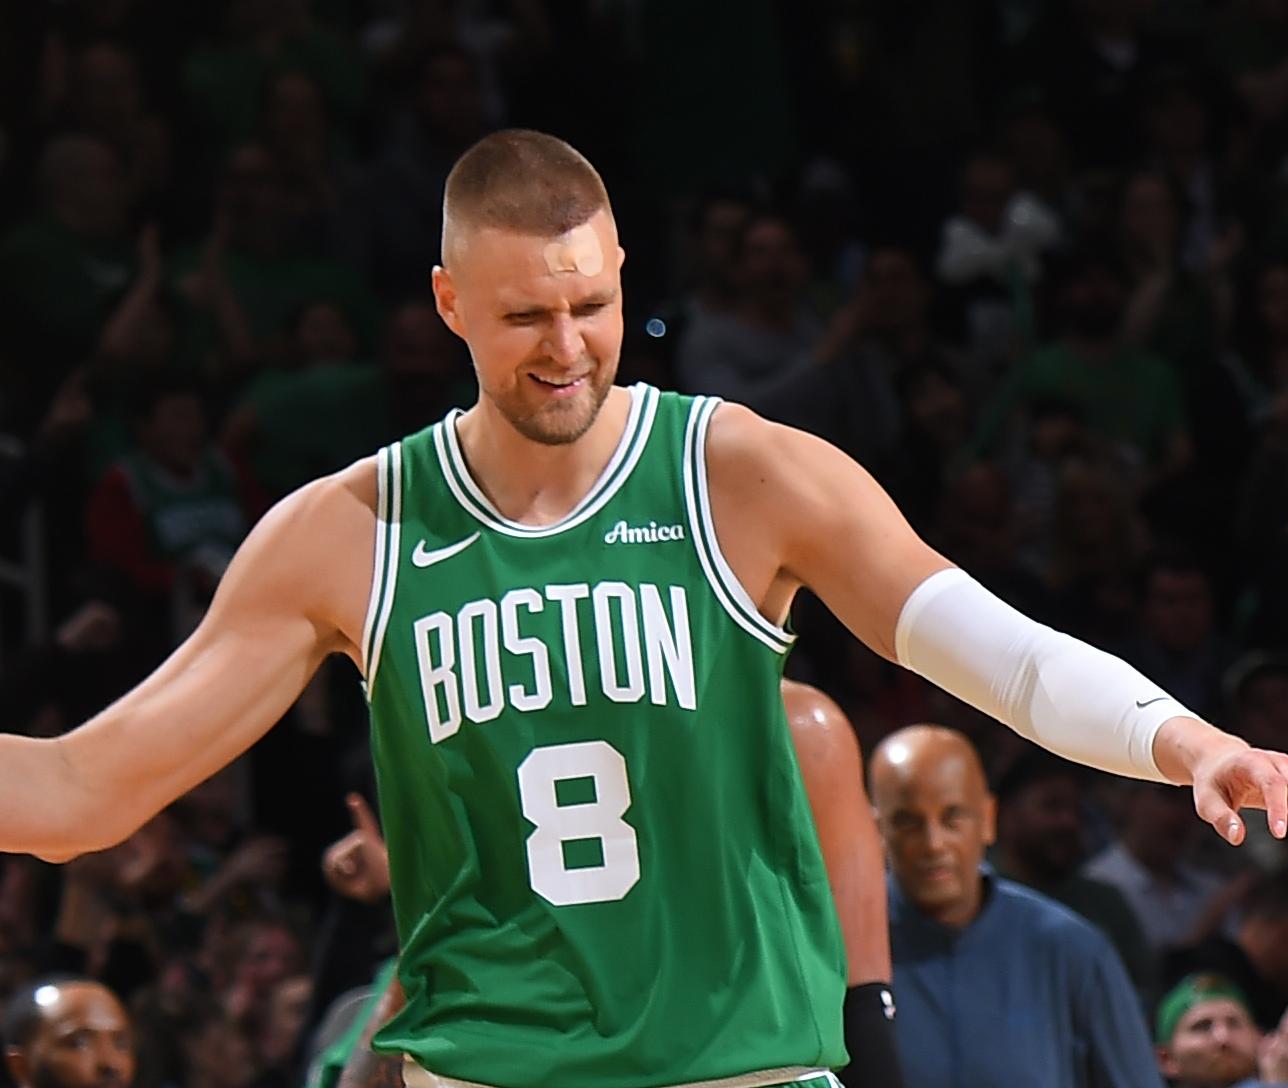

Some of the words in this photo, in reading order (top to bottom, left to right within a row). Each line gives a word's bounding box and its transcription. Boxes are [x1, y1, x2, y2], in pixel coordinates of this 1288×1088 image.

[604, 520, 685, 545] Amica
[413, 580, 697, 744] BOSTON
[516, 740, 641, 906] 8
